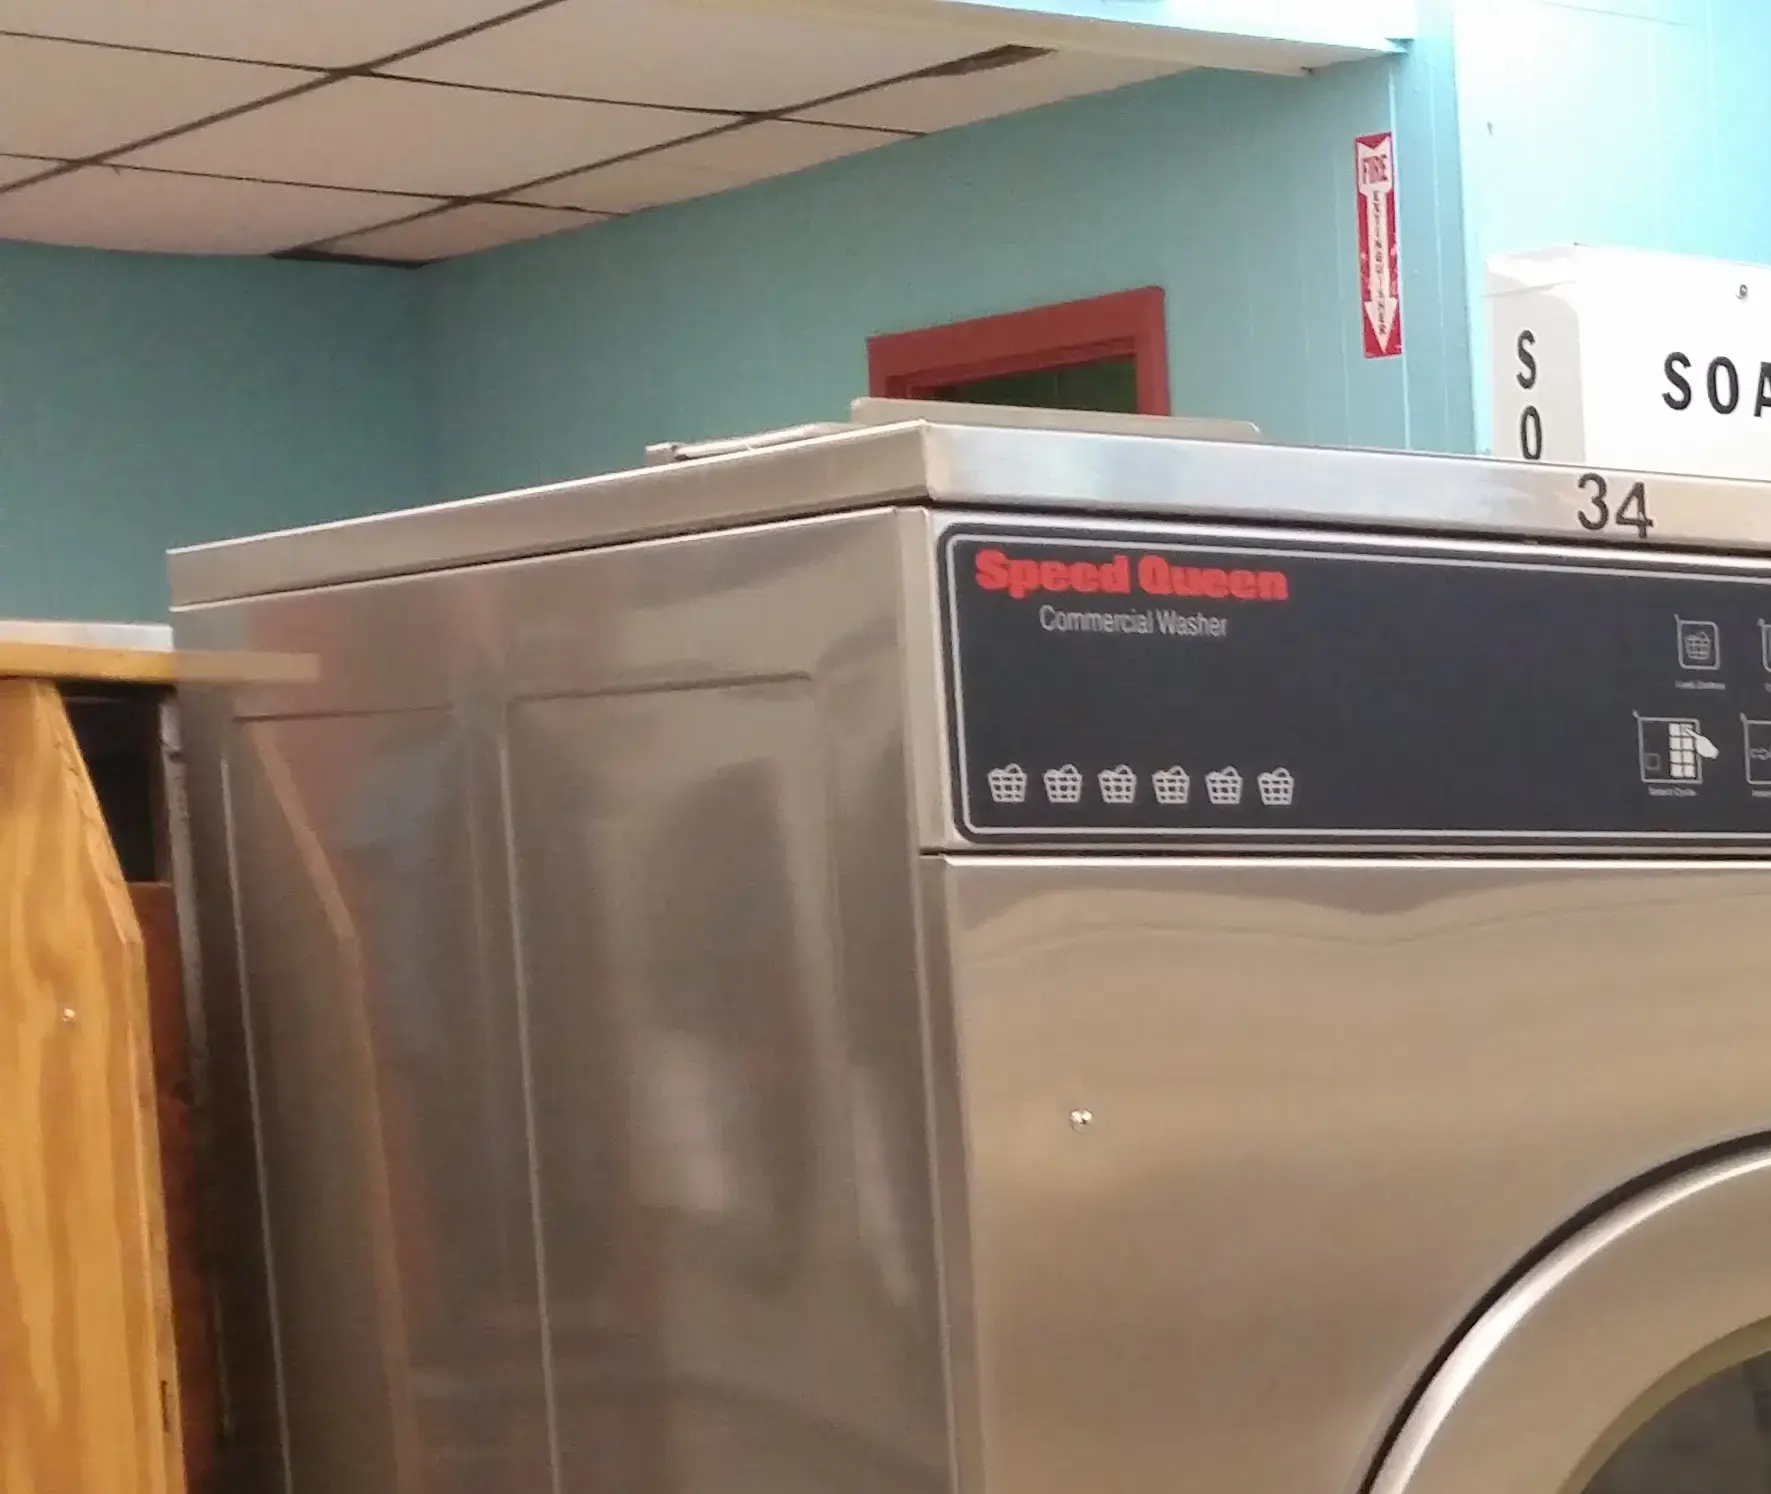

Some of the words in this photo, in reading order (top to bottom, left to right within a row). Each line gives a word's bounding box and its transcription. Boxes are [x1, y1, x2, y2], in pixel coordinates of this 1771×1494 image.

[1576, 472, 1654, 539] 34
[975, 549, 1131, 599] Speed
[1138, 554, 1288, 600] Queen
[1039, 604, 1153, 634] Commercial
[1156, 608, 1228, 638] Washer
